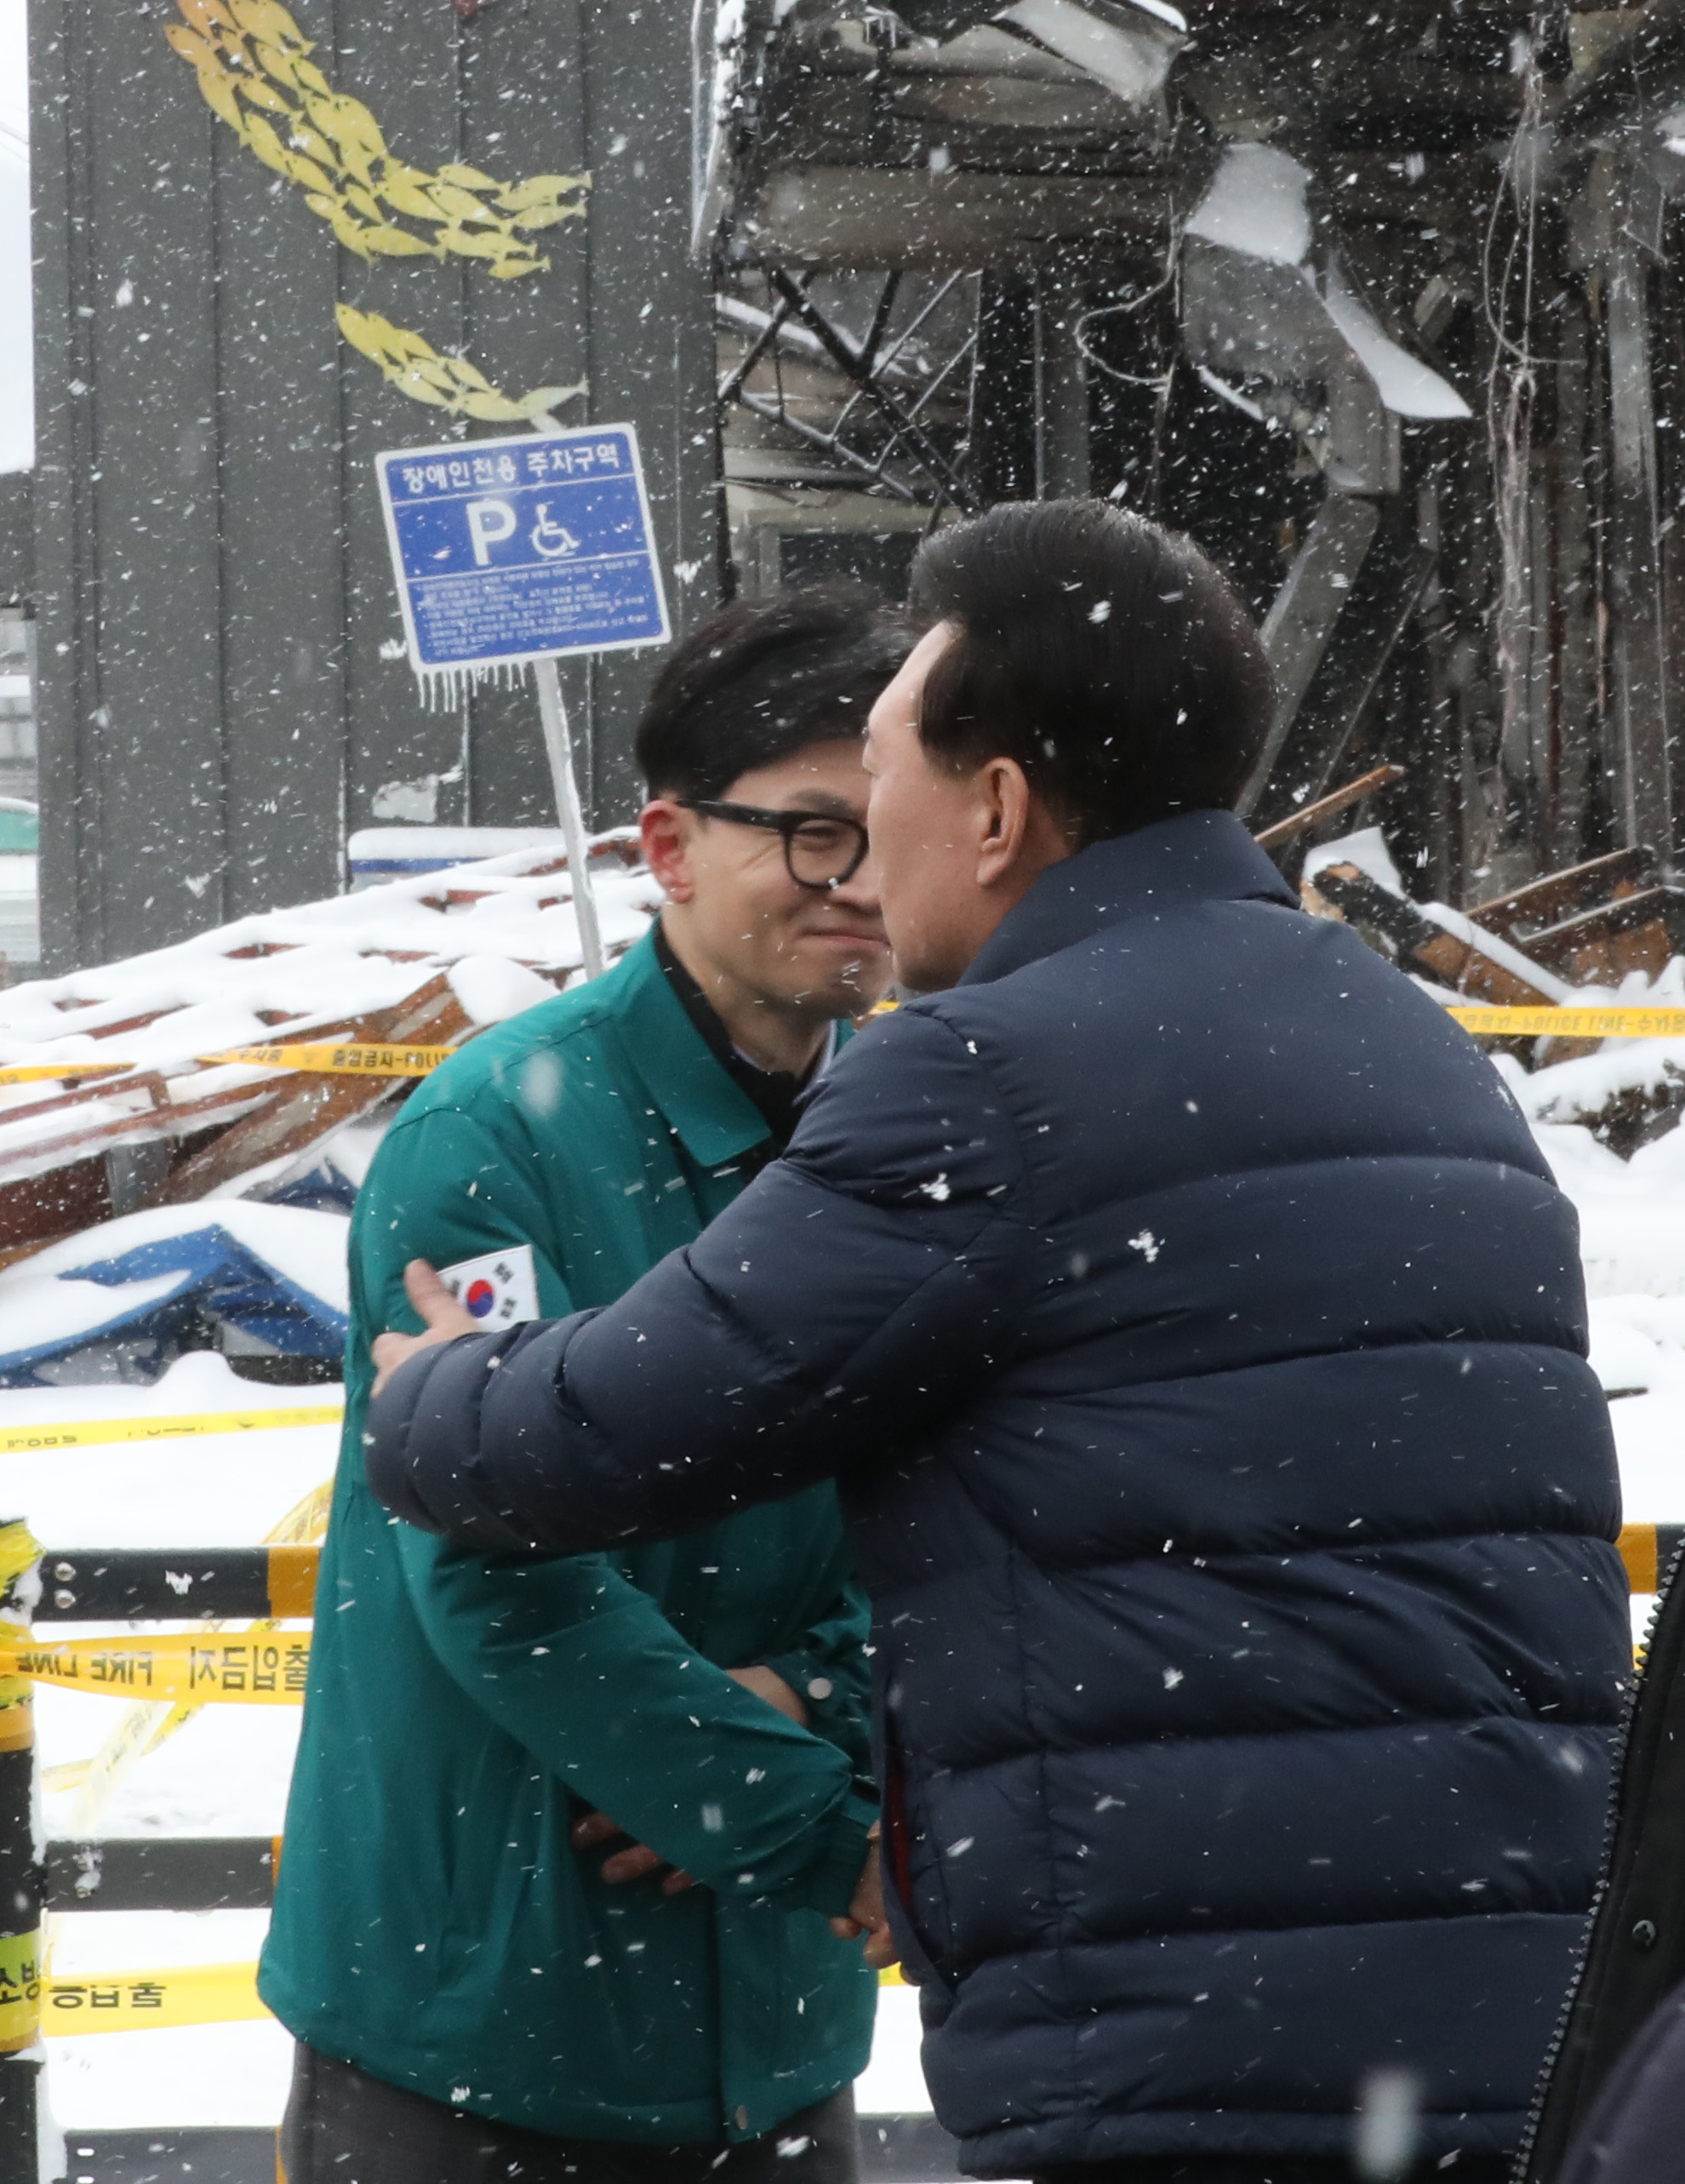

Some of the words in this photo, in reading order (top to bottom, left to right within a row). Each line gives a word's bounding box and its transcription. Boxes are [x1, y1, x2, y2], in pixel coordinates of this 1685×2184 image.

[403, 455, 517, 494] 장애인전용
[527, 443, 620, 477] 주차구역
[466, 499, 517, 566] P
